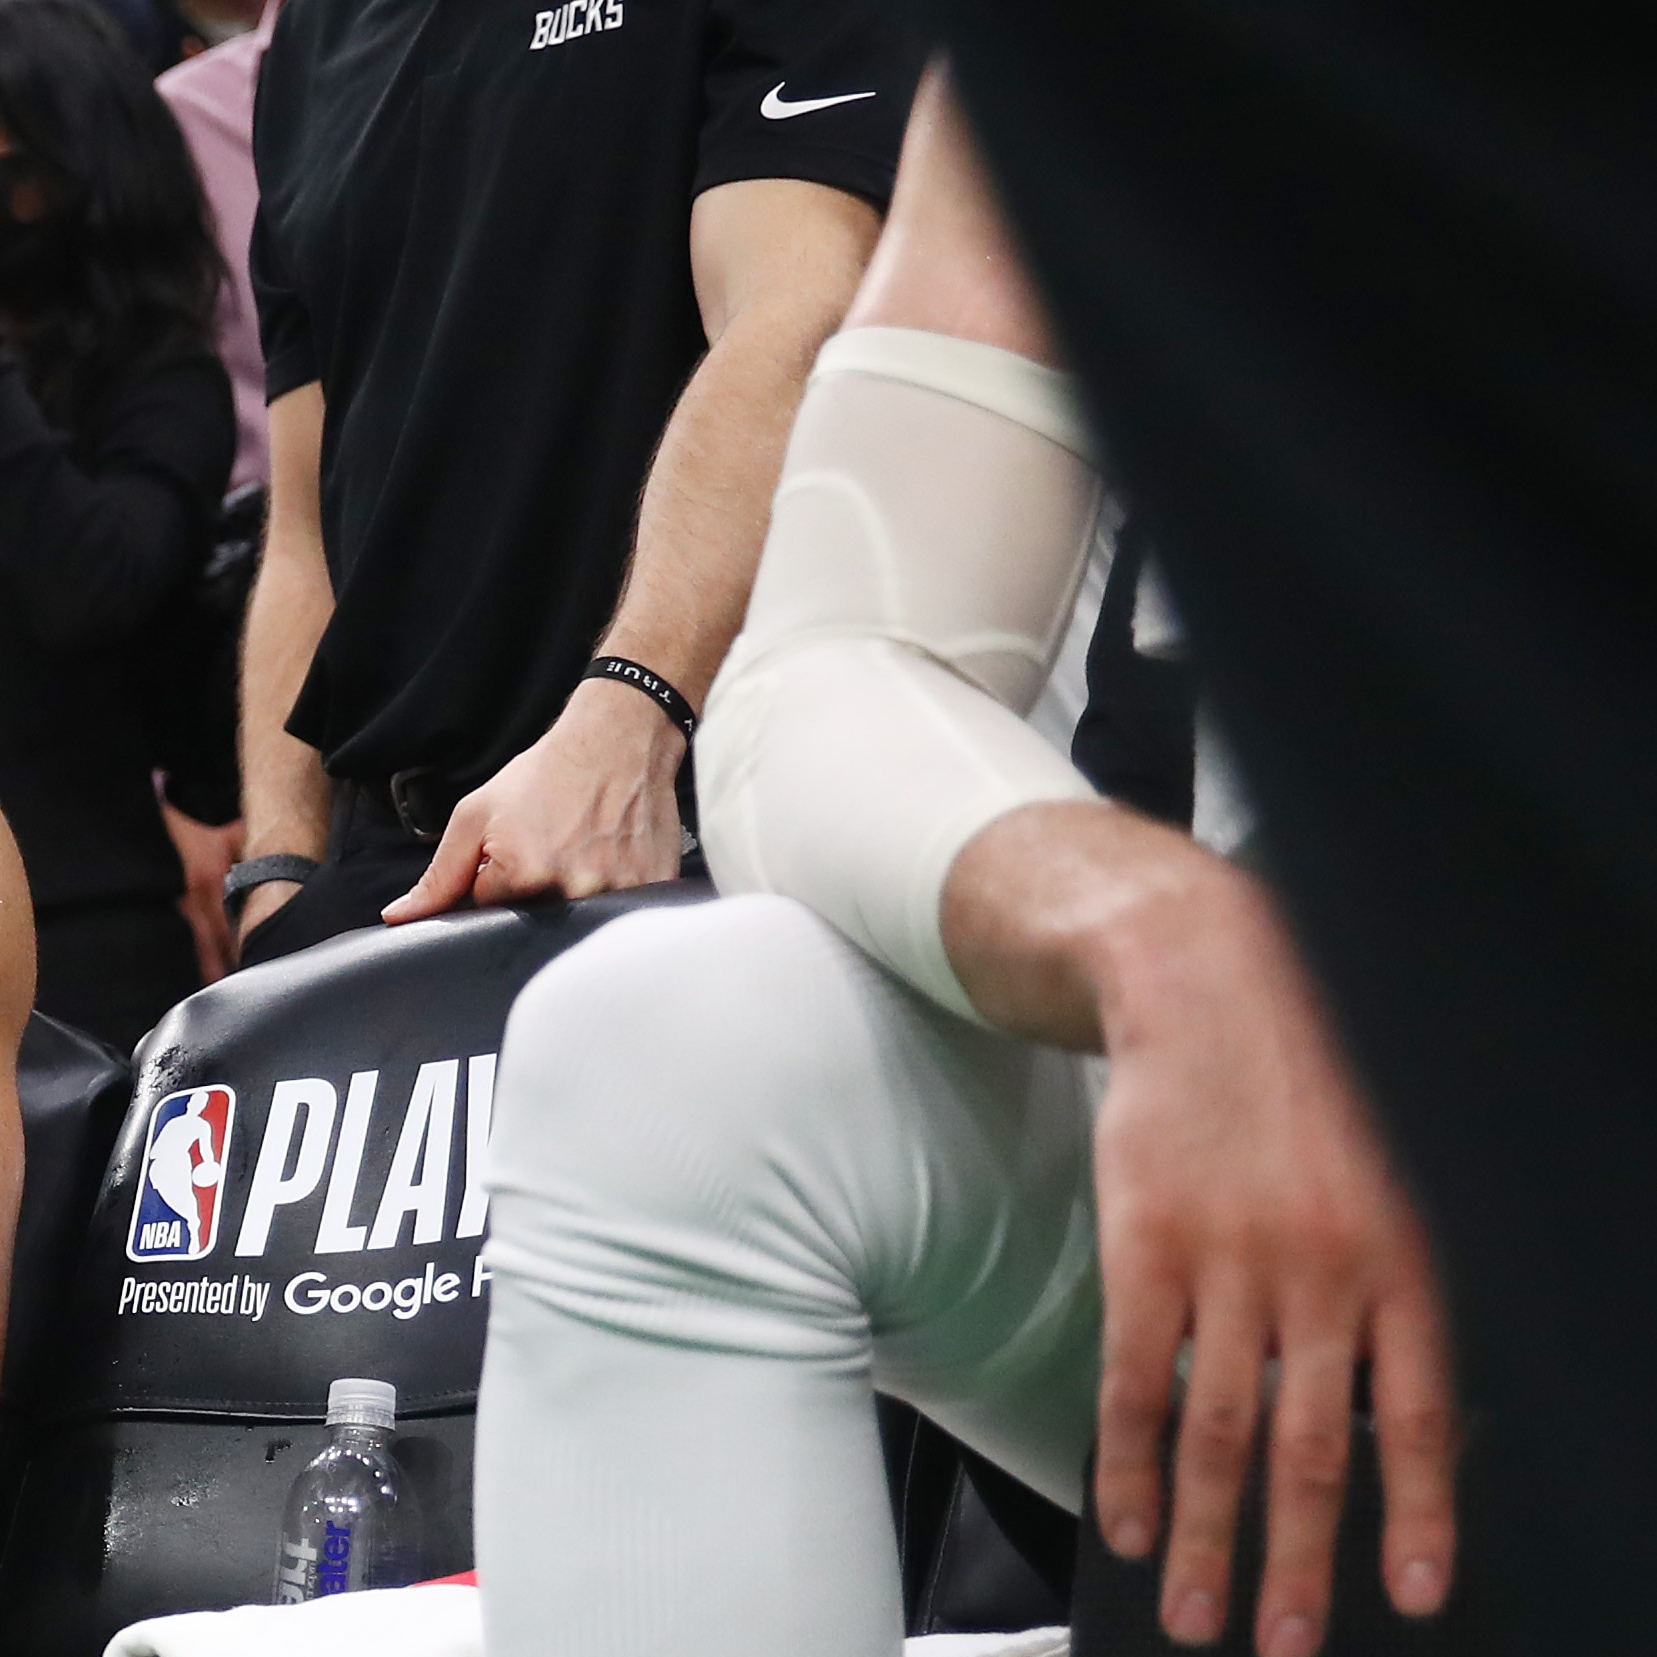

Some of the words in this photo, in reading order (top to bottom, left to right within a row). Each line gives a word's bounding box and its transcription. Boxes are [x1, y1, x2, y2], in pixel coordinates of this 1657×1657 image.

[529, 0, 623, 50] BUCKS
[606, 661, 672, 704] TRUE
[139, 1220, 181, 1250] NBA
[118, 1274, 238, 1316] Presented
[240, 1274, 270, 1322] by
[284, 1262, 460, 1320] Google
